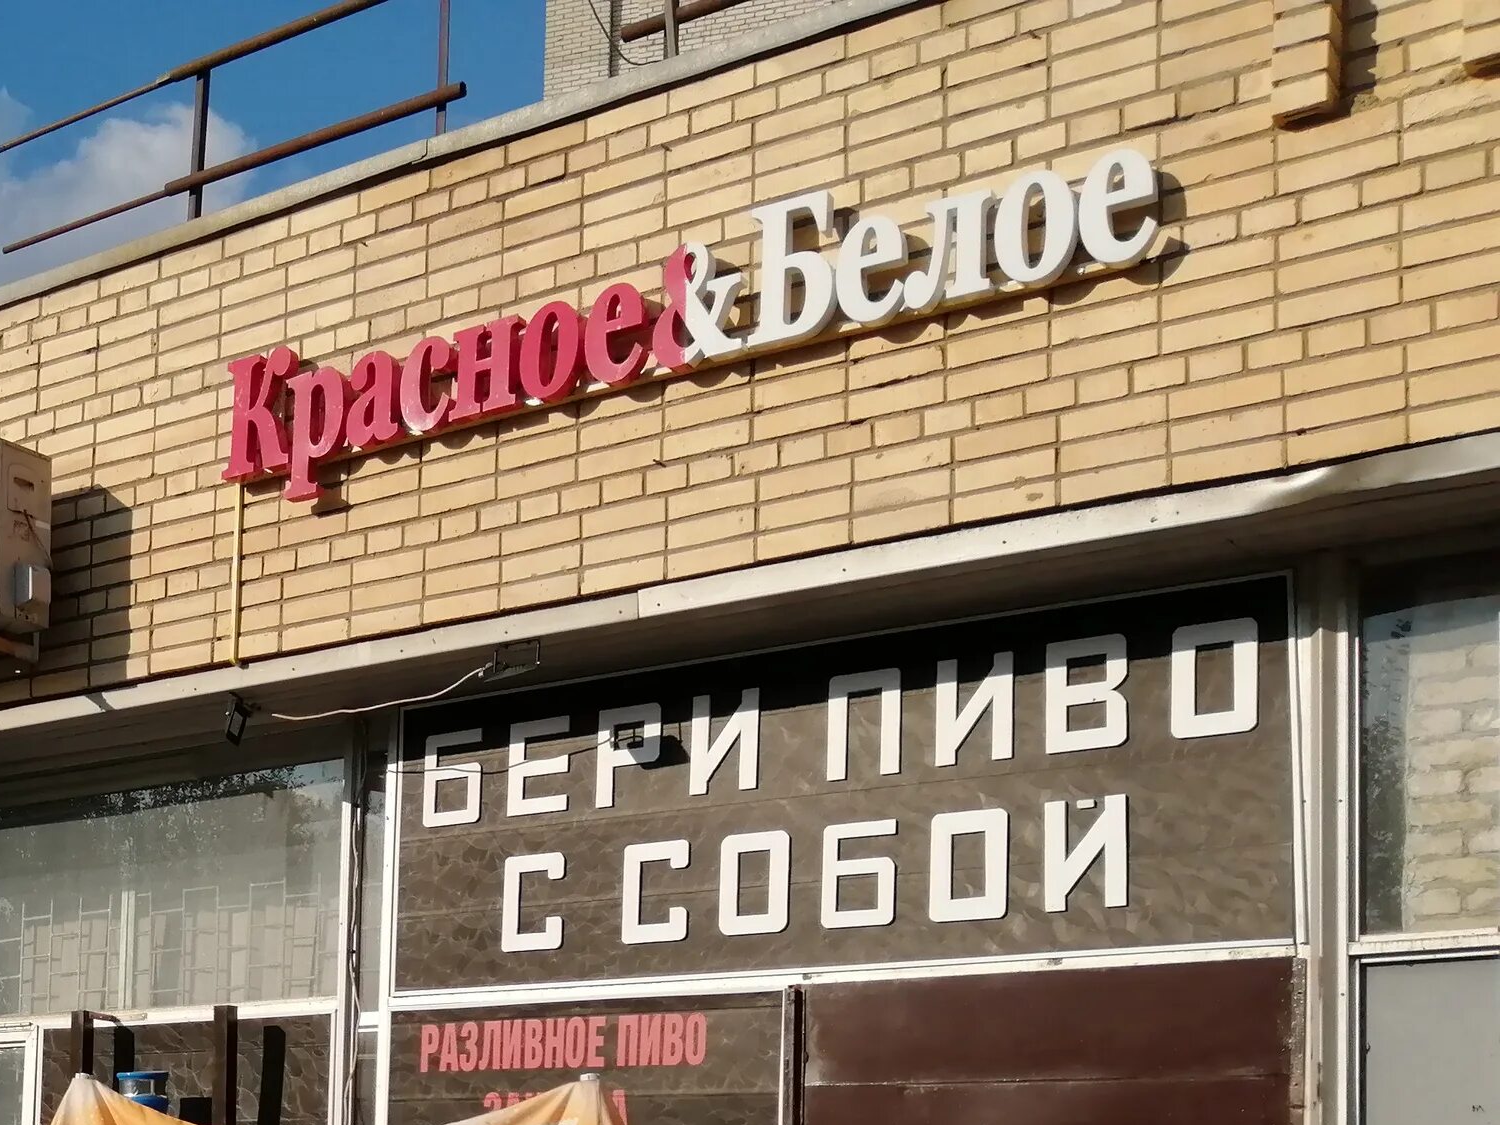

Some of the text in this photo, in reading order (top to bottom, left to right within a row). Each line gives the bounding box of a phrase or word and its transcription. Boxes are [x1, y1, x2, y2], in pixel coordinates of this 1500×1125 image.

[423, 616, 1260, 829] БЕРИ ПИВО
[501, 794, 1129, 953] С СОБОЙ
[420, 1012, 707, 1073] РАЗЛИВНОЕ ПИВО
